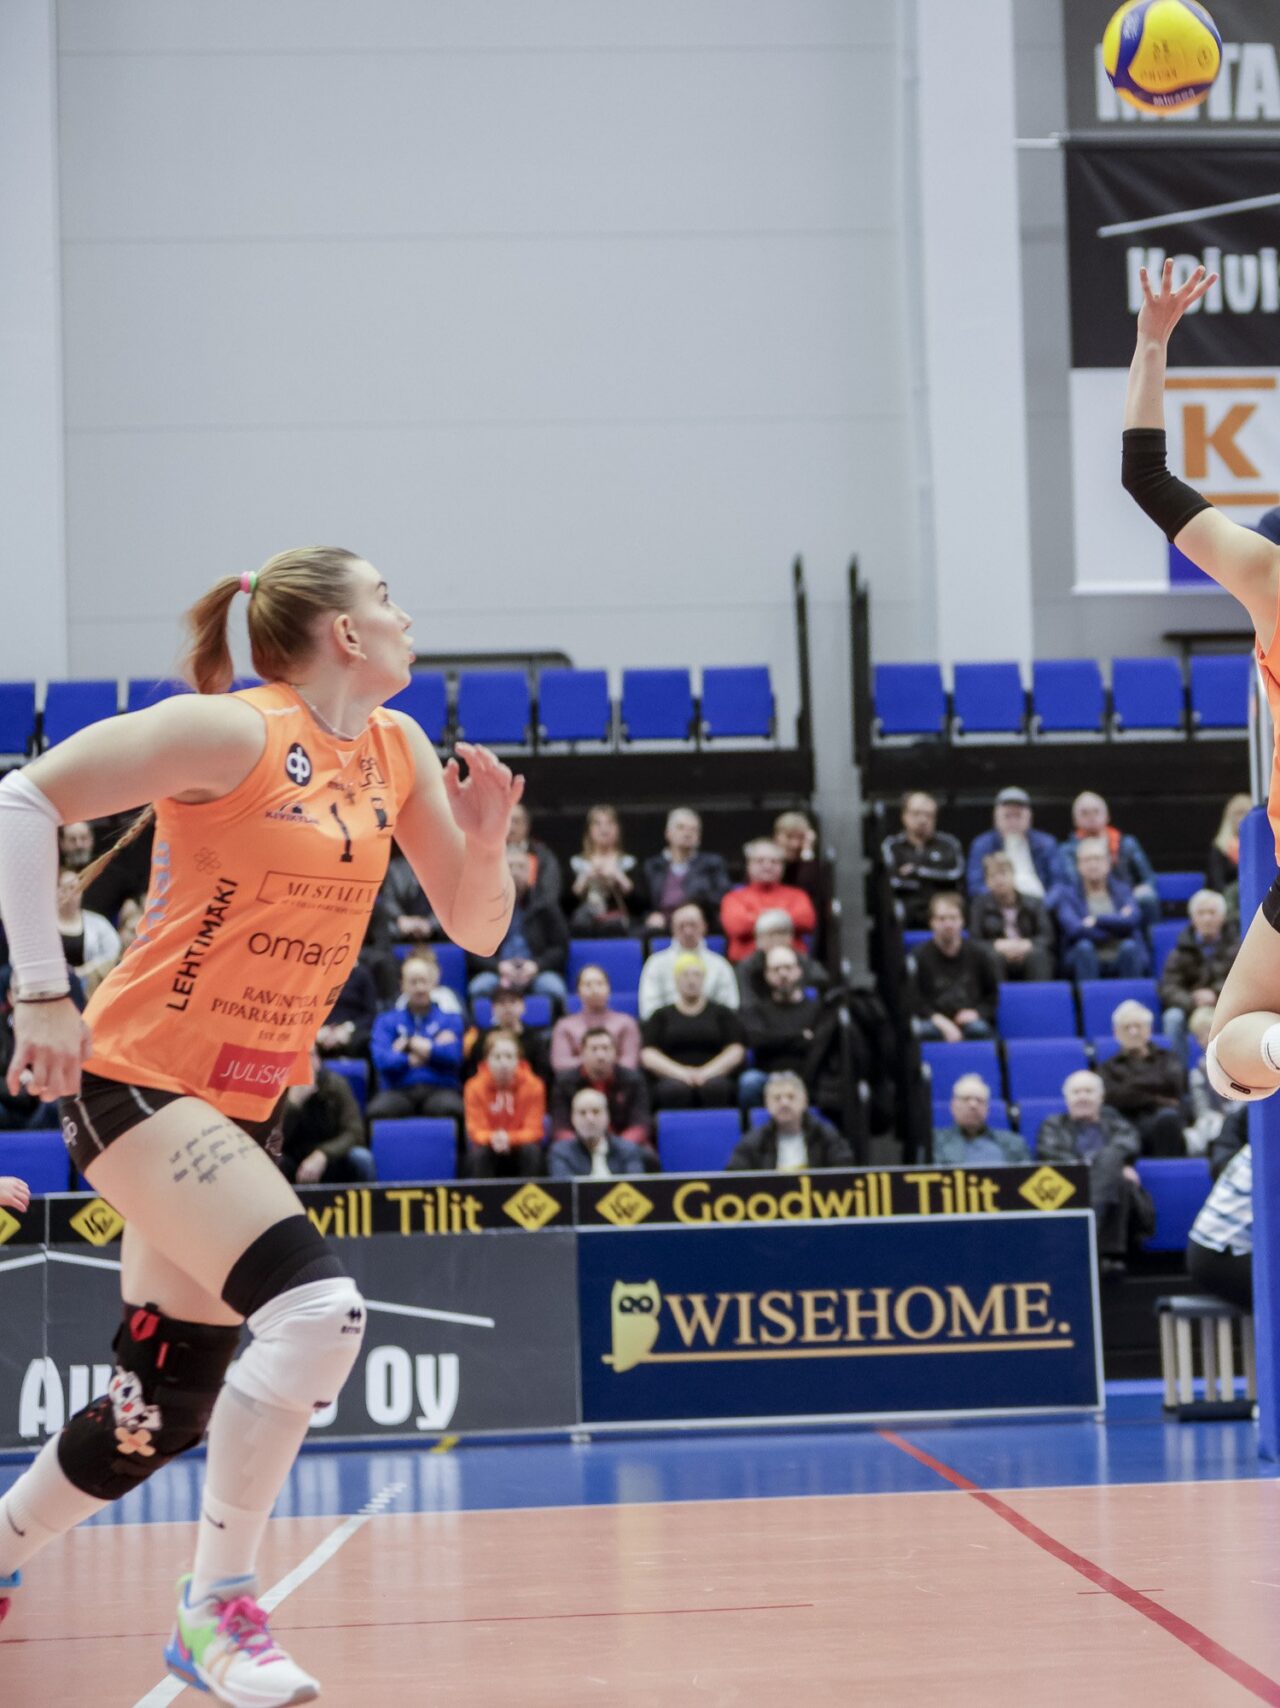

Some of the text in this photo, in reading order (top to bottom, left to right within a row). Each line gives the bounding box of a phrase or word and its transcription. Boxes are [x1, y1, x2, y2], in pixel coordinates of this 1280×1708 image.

[1182, 403, 1262, 479] K
[384, 1186, 483, 1237] Tilit
[673, 1168, 1000, 1226] Goodwill Tilit
[667, 1282, 1072, 1347] WISEHOME.
[365, 1346, 459, 1430] Oy
